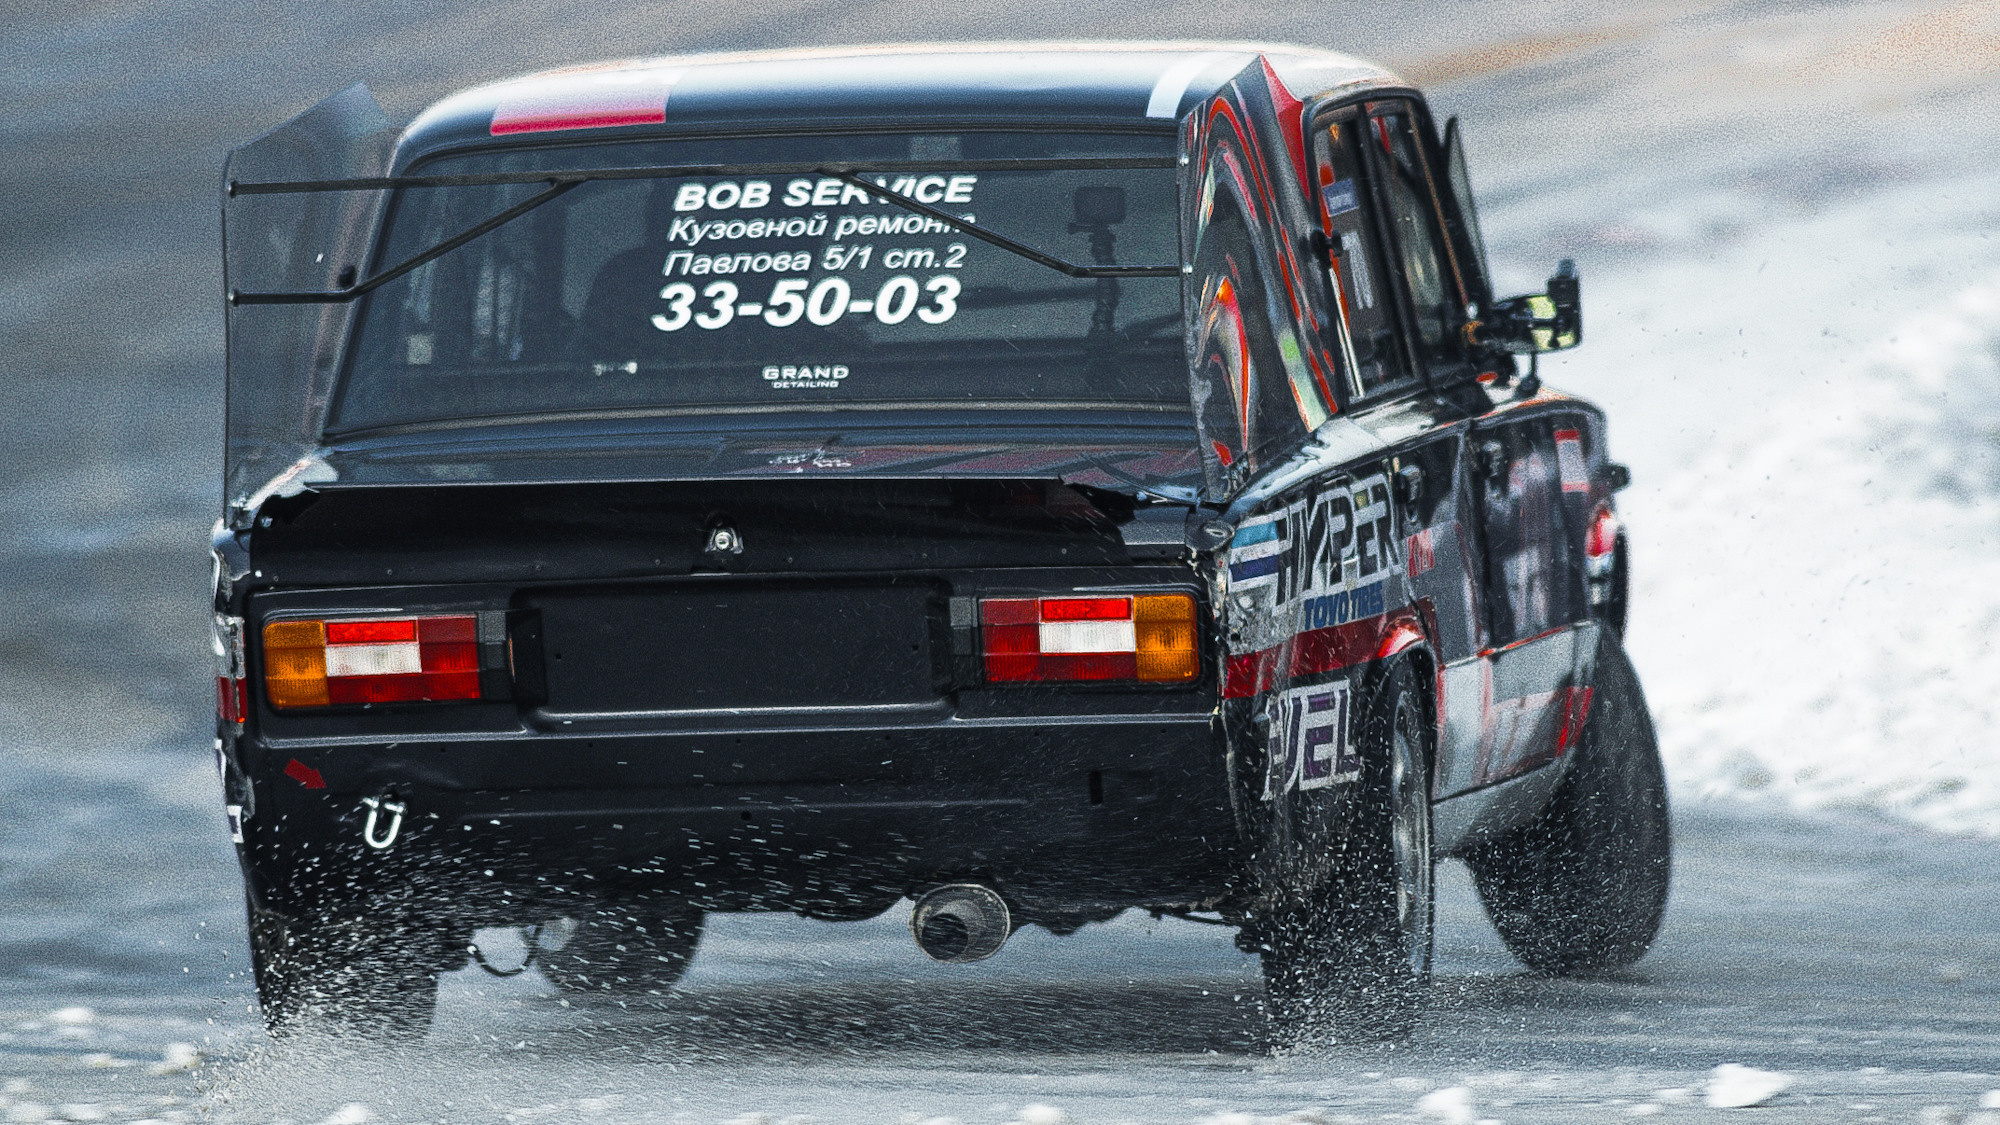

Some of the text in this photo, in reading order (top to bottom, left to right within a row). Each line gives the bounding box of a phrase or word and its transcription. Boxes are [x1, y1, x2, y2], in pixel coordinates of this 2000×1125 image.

[673, 180, 772, 212] BOB
[667, 213, 829, 246] Кузовной
[663, 251, 812, 276] Павлова
[821, 244, 873, 271] 5/1
[651, 274, 962, 332] 33-50-03
[762, 365, 850, 380] GRAND
[771, 380, 840, 389] DETAILING
[1268, 478, 1402, 610] HYPER
[1304, 580, 1384, 631] TOYO TIRES
